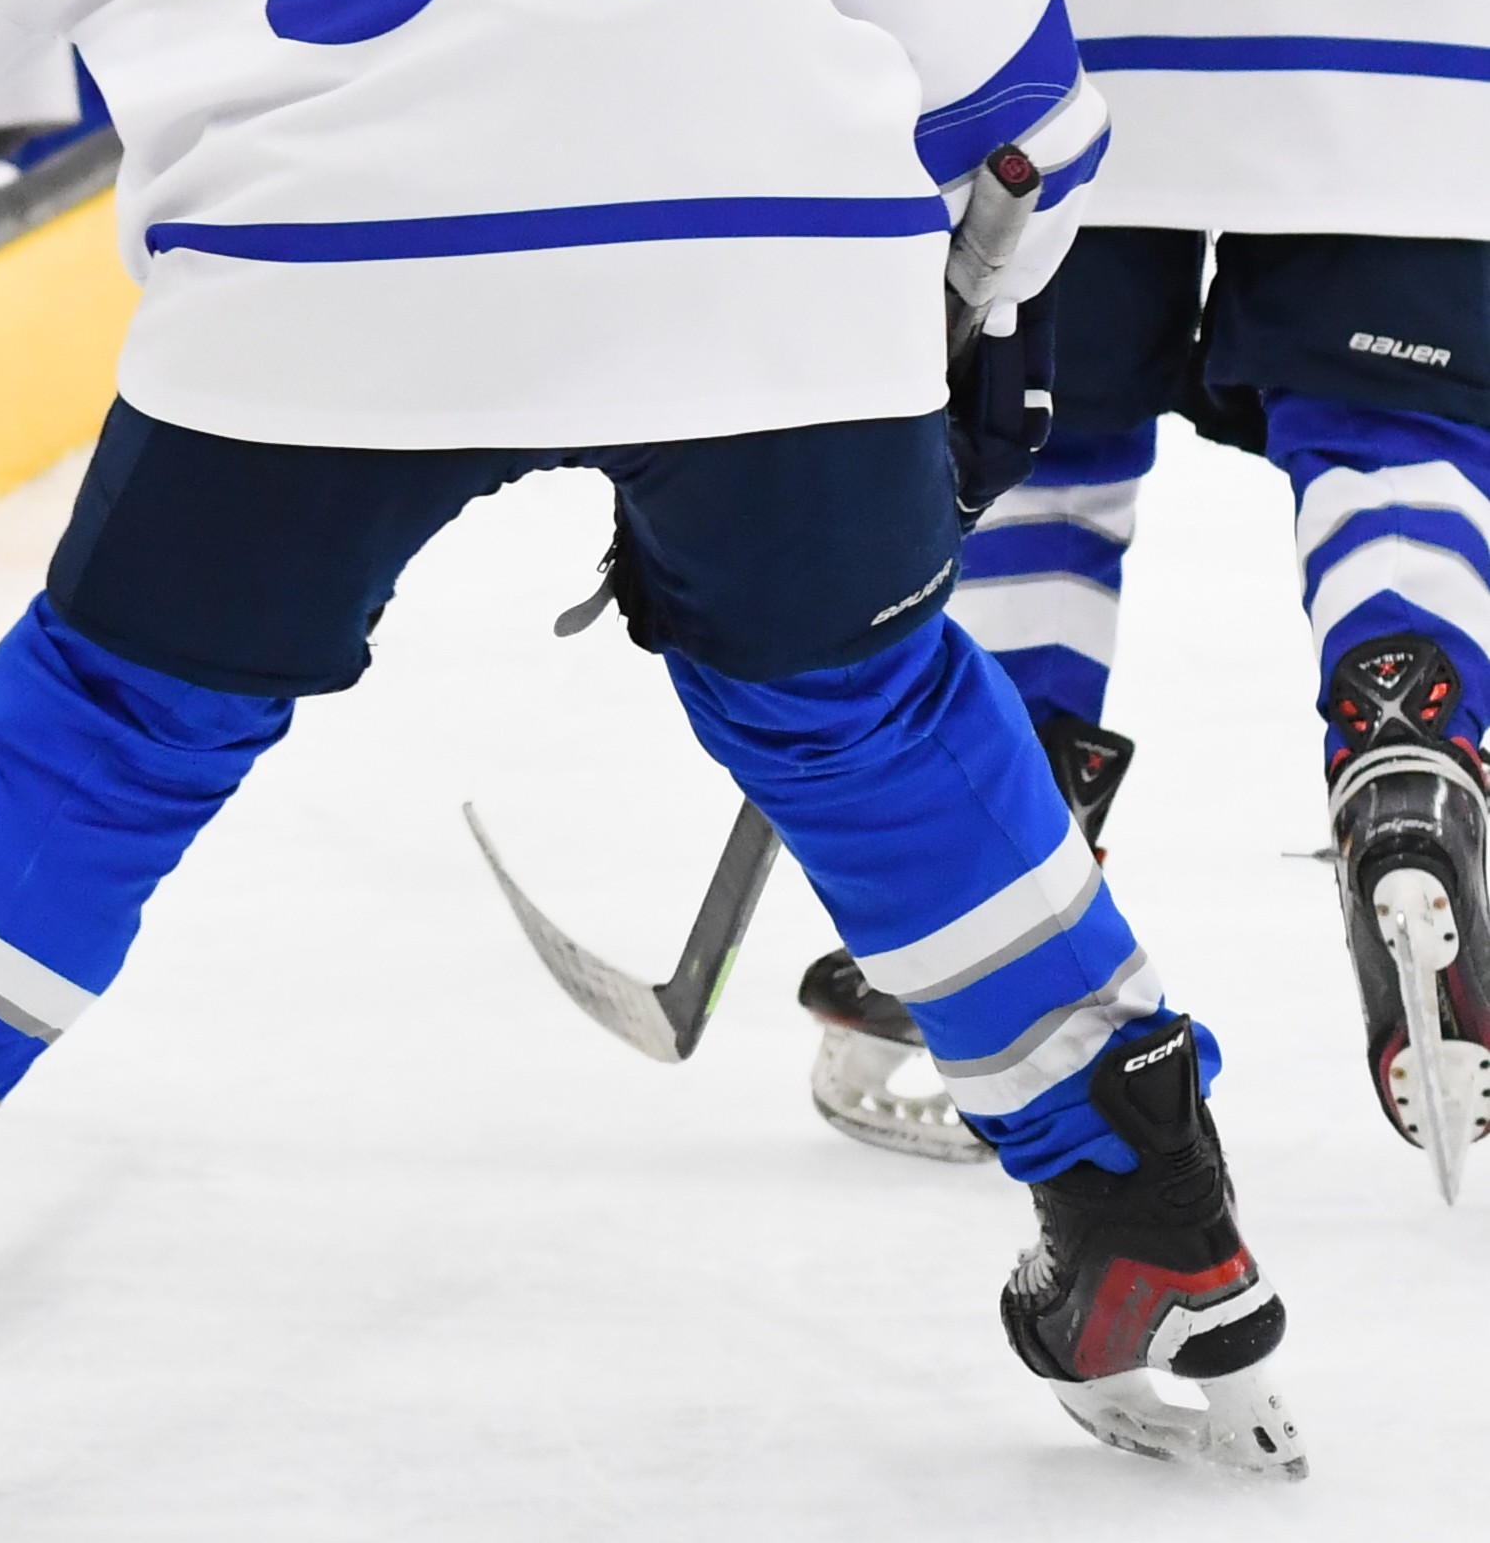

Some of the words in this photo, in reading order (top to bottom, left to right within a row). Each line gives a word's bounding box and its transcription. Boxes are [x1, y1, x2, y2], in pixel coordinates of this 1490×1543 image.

[1347, 331, 1453, 368] BAUER
[870, 556, 955, 627] BAUER
[1123, 1032, 1186, 1075] CCM
